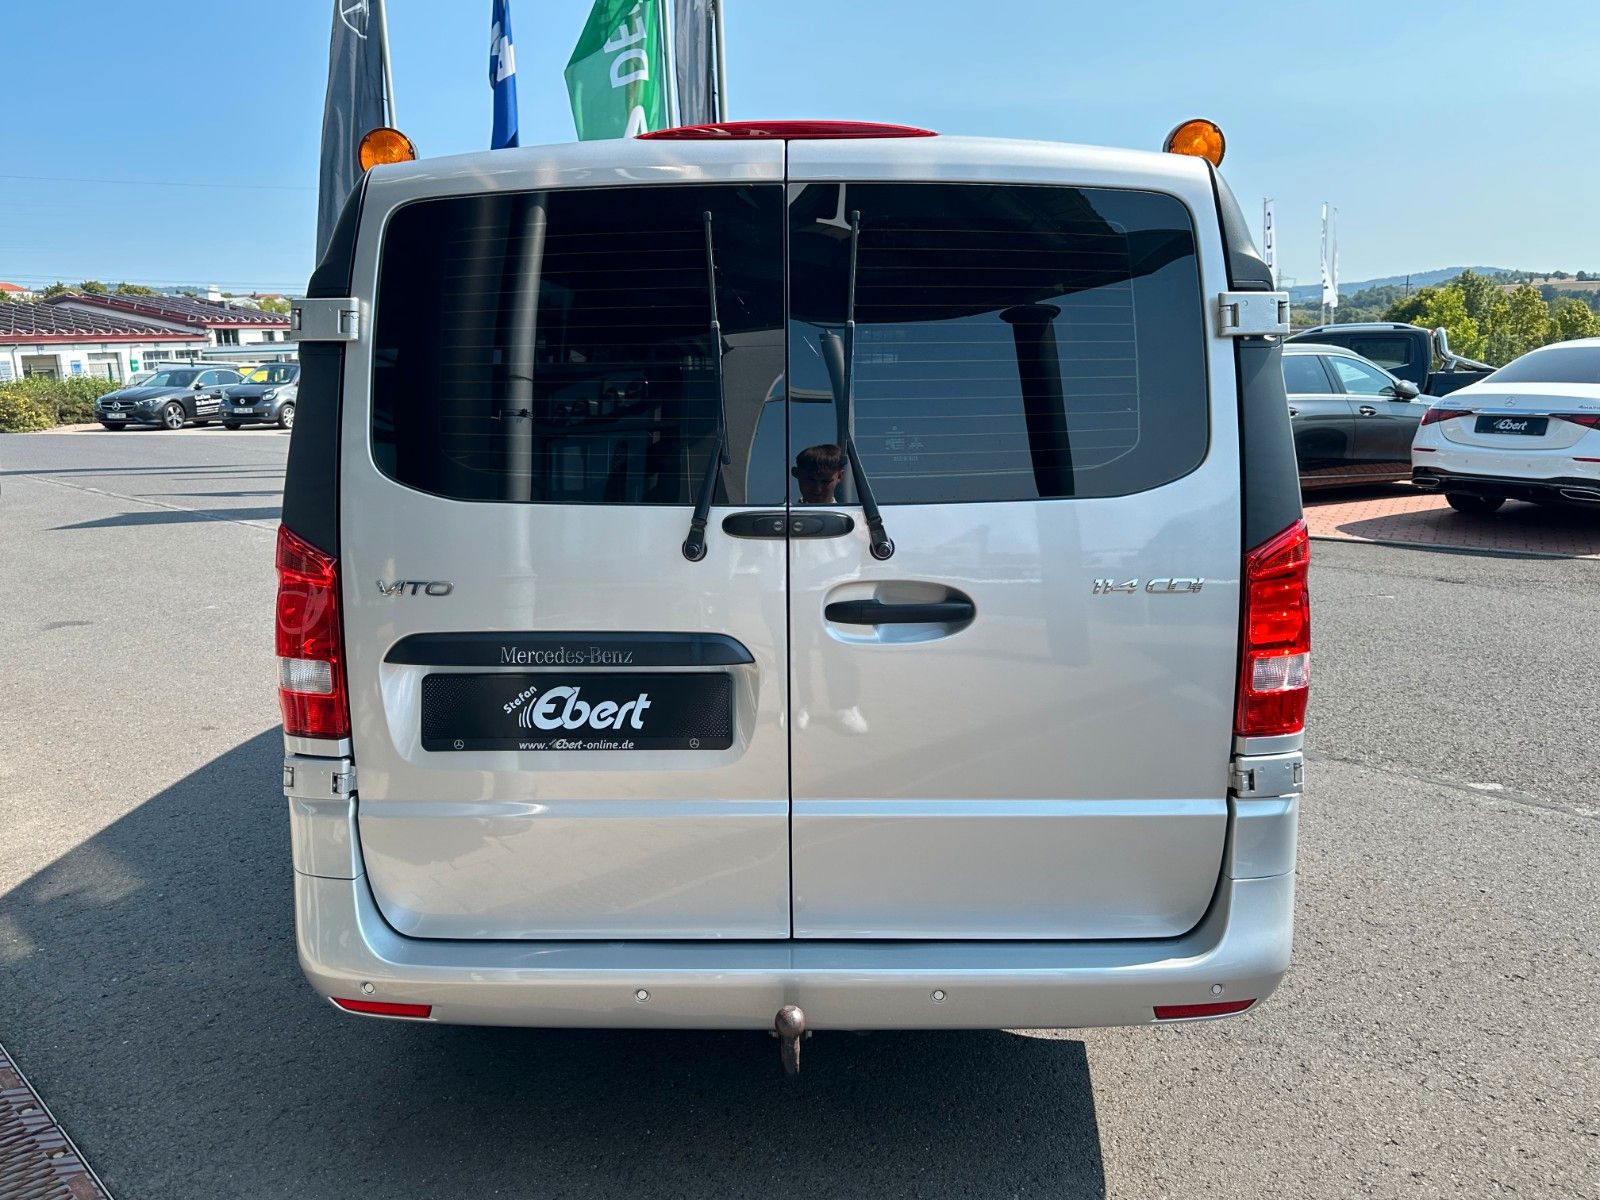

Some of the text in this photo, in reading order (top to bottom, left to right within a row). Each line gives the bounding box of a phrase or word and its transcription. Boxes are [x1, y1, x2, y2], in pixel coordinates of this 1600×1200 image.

[376, 579, 455, 597] VITO
[1093, 577, 1205, 595] 114 CDI
[500, 646, 634, 664] Mercedes-Benz
[503, 685, 538, 714] Stefan
[532, 685, 652, 730] Ebert
[519, 739, 635, 750] www.Ebert-online.de
